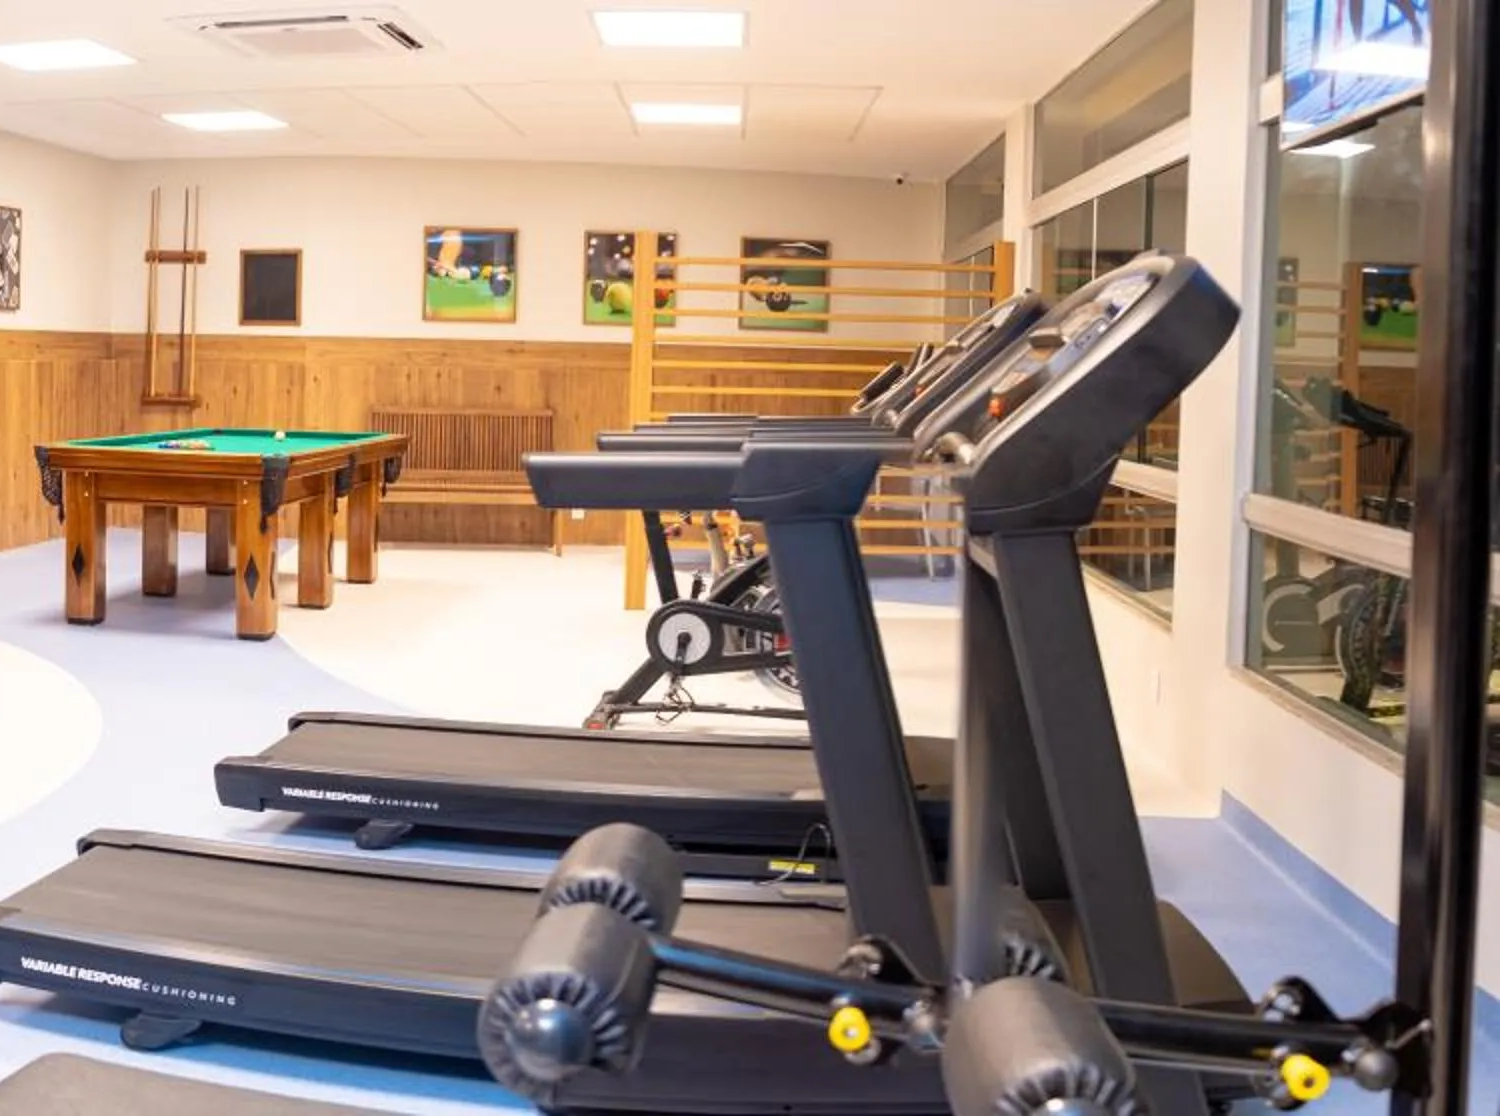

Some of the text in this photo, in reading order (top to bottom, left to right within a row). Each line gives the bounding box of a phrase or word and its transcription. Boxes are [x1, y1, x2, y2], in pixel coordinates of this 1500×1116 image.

[21, 956, 236, 1006] VARIABLE RESPONSE CUSHIONING
